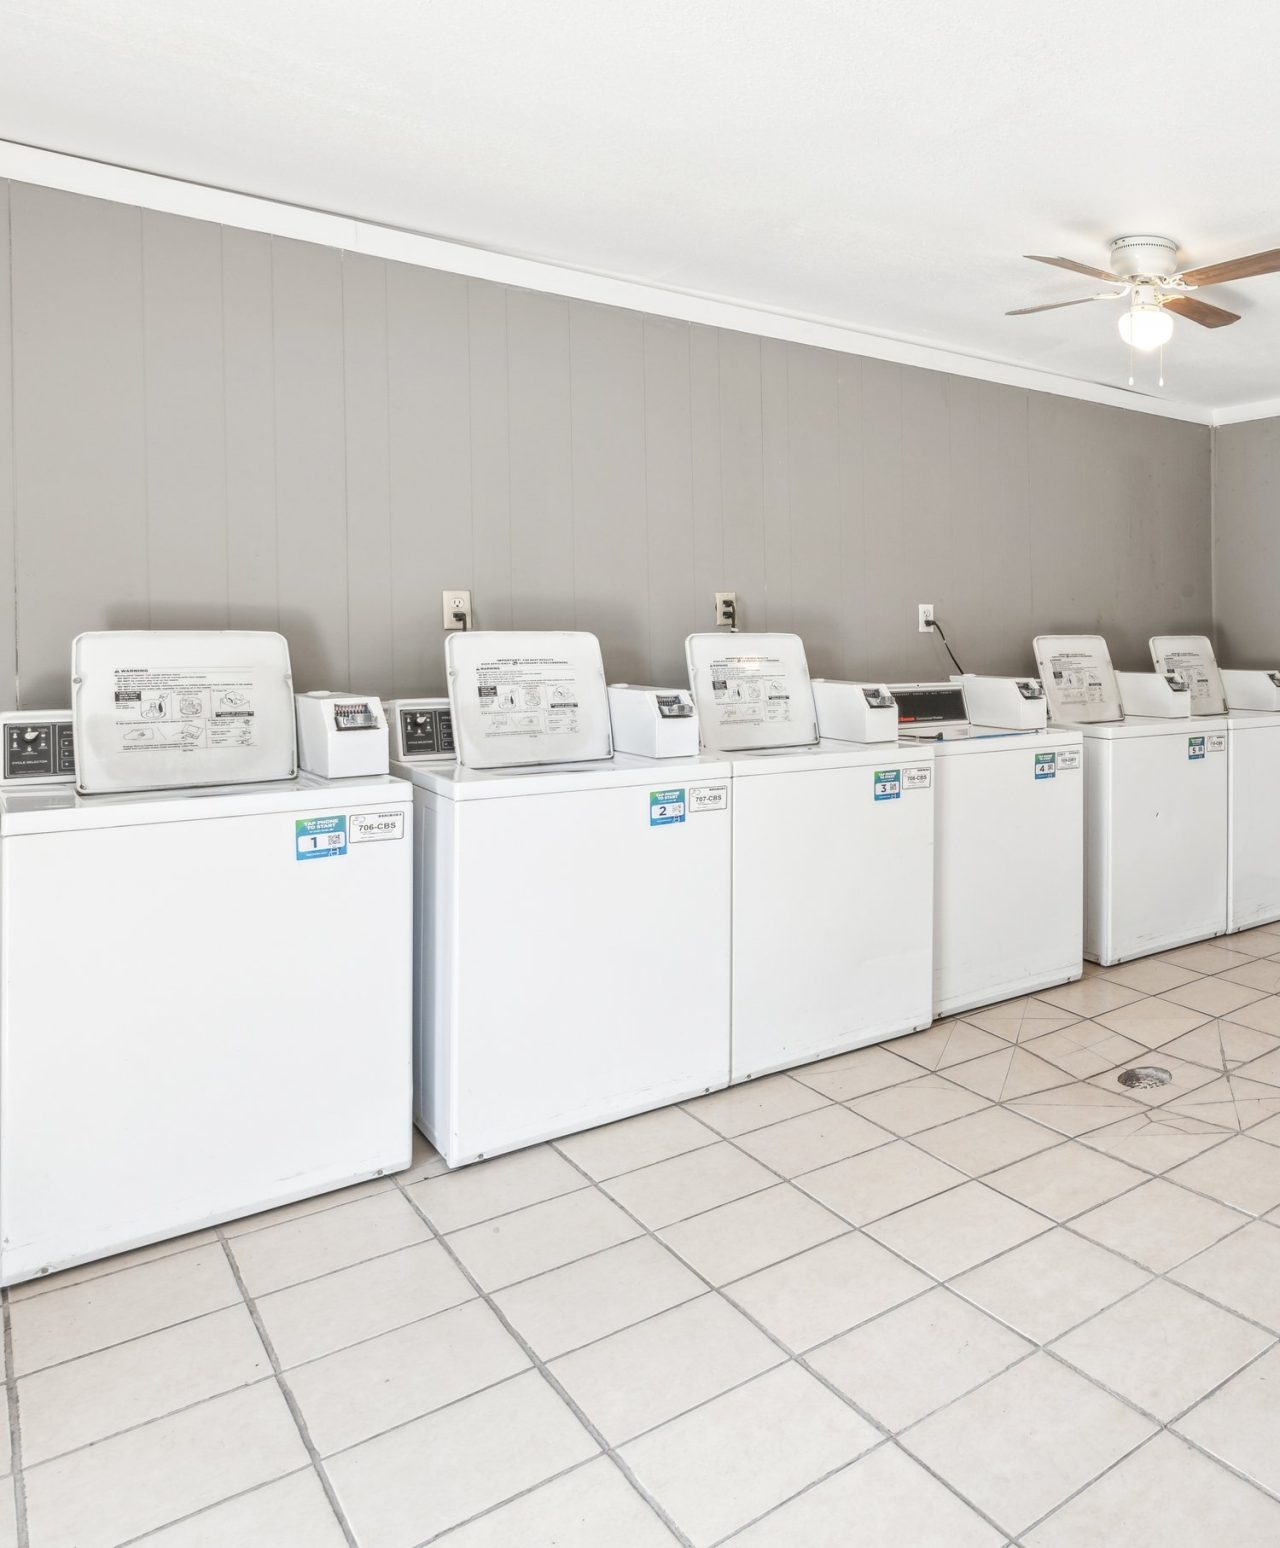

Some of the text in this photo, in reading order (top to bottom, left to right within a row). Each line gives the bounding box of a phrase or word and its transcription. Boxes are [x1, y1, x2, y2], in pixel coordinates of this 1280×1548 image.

[1039, 764, 1045, 772] 4
[881, 784, 887, 793] 3
[695, 794, 722, 802] 707-CBS
[659, 805, 667, 816] 2
[358, 822, 397, 831] 706-CBS
[310, 836, 318, 849] 1
